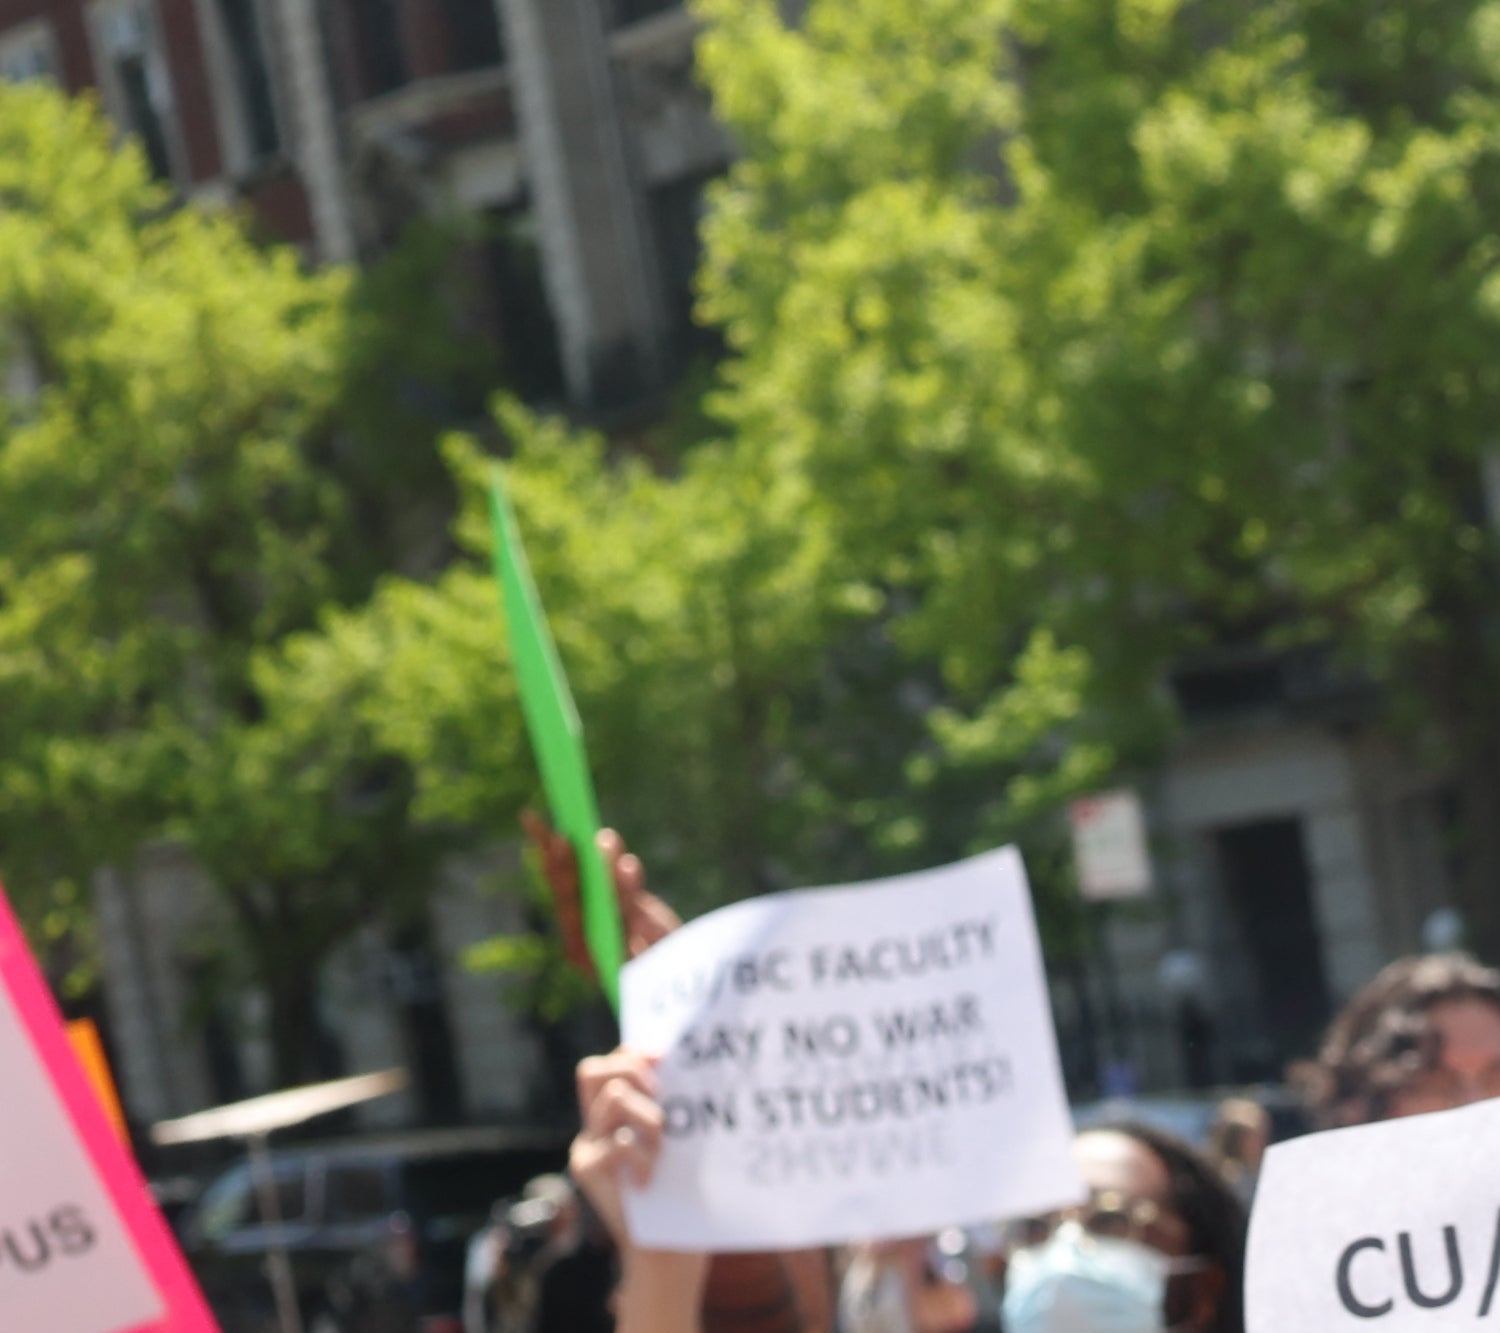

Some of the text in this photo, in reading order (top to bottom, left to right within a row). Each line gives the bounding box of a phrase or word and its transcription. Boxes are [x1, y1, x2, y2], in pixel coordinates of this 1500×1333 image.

[811, 922, 997, 984] FACULTY
[676, 994, 982, 1070] SAY NO WAR
[661, 1059, 1013, 1138] ON STUDENTS!
